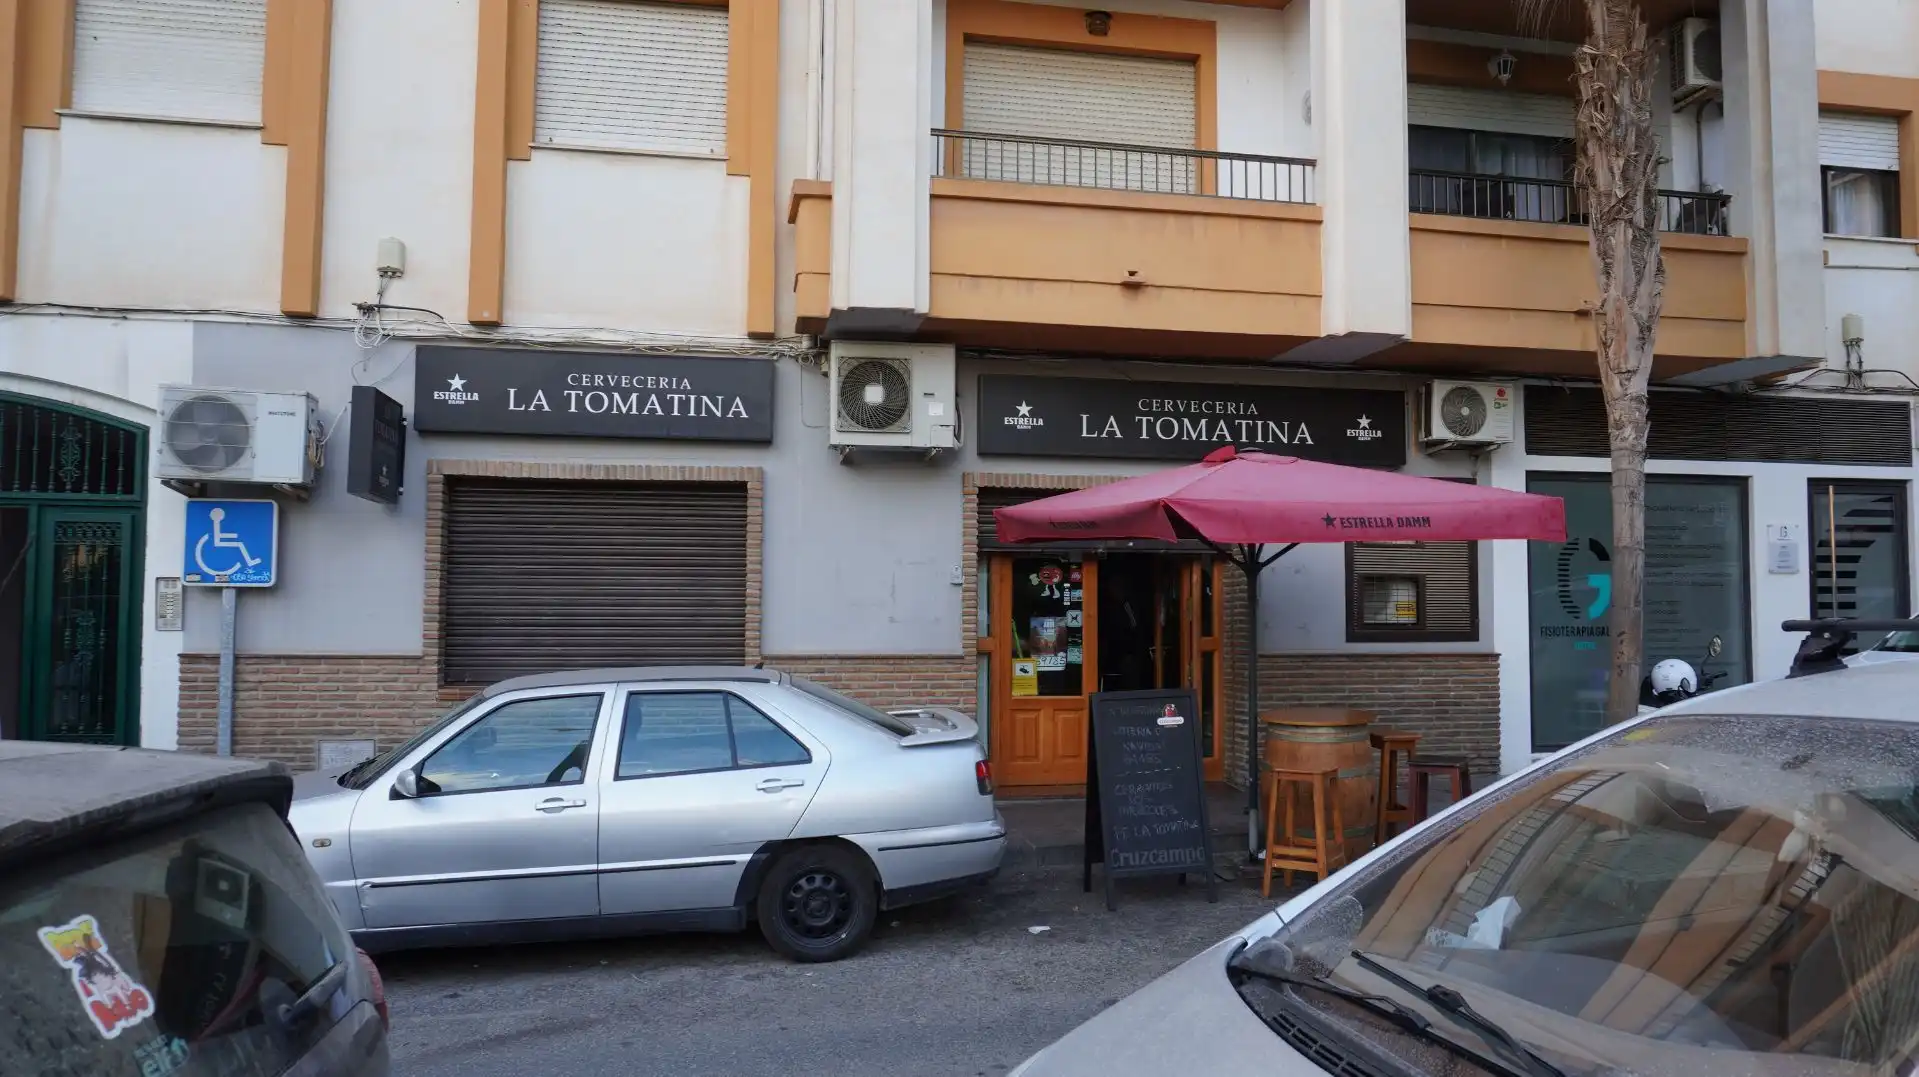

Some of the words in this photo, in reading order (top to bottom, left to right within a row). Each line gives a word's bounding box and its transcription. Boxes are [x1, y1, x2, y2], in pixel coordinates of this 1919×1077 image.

[567, 373, 692, 390] CERVECERIA
[433, 391, 479, 401] ESTRELLA
[507, 388, 552, 412] LA
[564, 390, 749, 418] TOMATINA
[1138, 399, 1258, 415] CERVECERIA
[1004, 417, 1044, 426] ESTRELLA
[1080, 414, 1124, 438] LA
[1135, 416, 1314, 445] TOMATINA
[1347, 429, 1382, 438] ESTRELLA
[1340, 517, 1394, 529] ESTRELLA
[1396, 516, 1431, 528] DAMM
[1110, 846, 1205, 868] Cruzcampo
